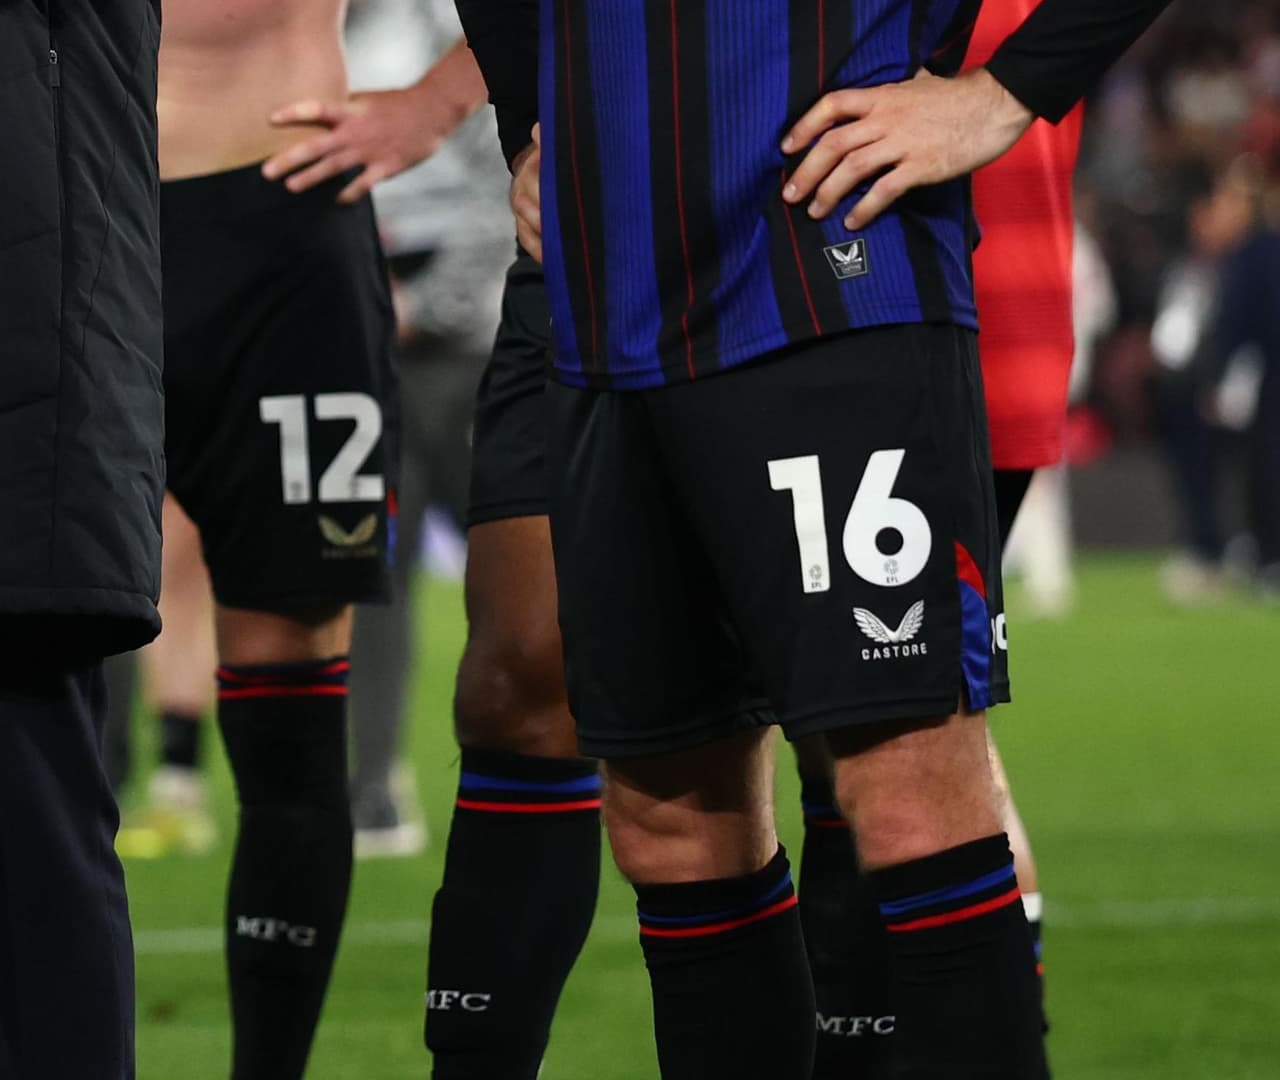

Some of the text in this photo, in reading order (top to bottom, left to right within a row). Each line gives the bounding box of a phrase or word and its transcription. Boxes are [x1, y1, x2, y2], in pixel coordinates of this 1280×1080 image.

[258, 391, 386, 505] 12
[767, 448, 933, 594] 16
[861, 642, 928, 661] CASTORE
